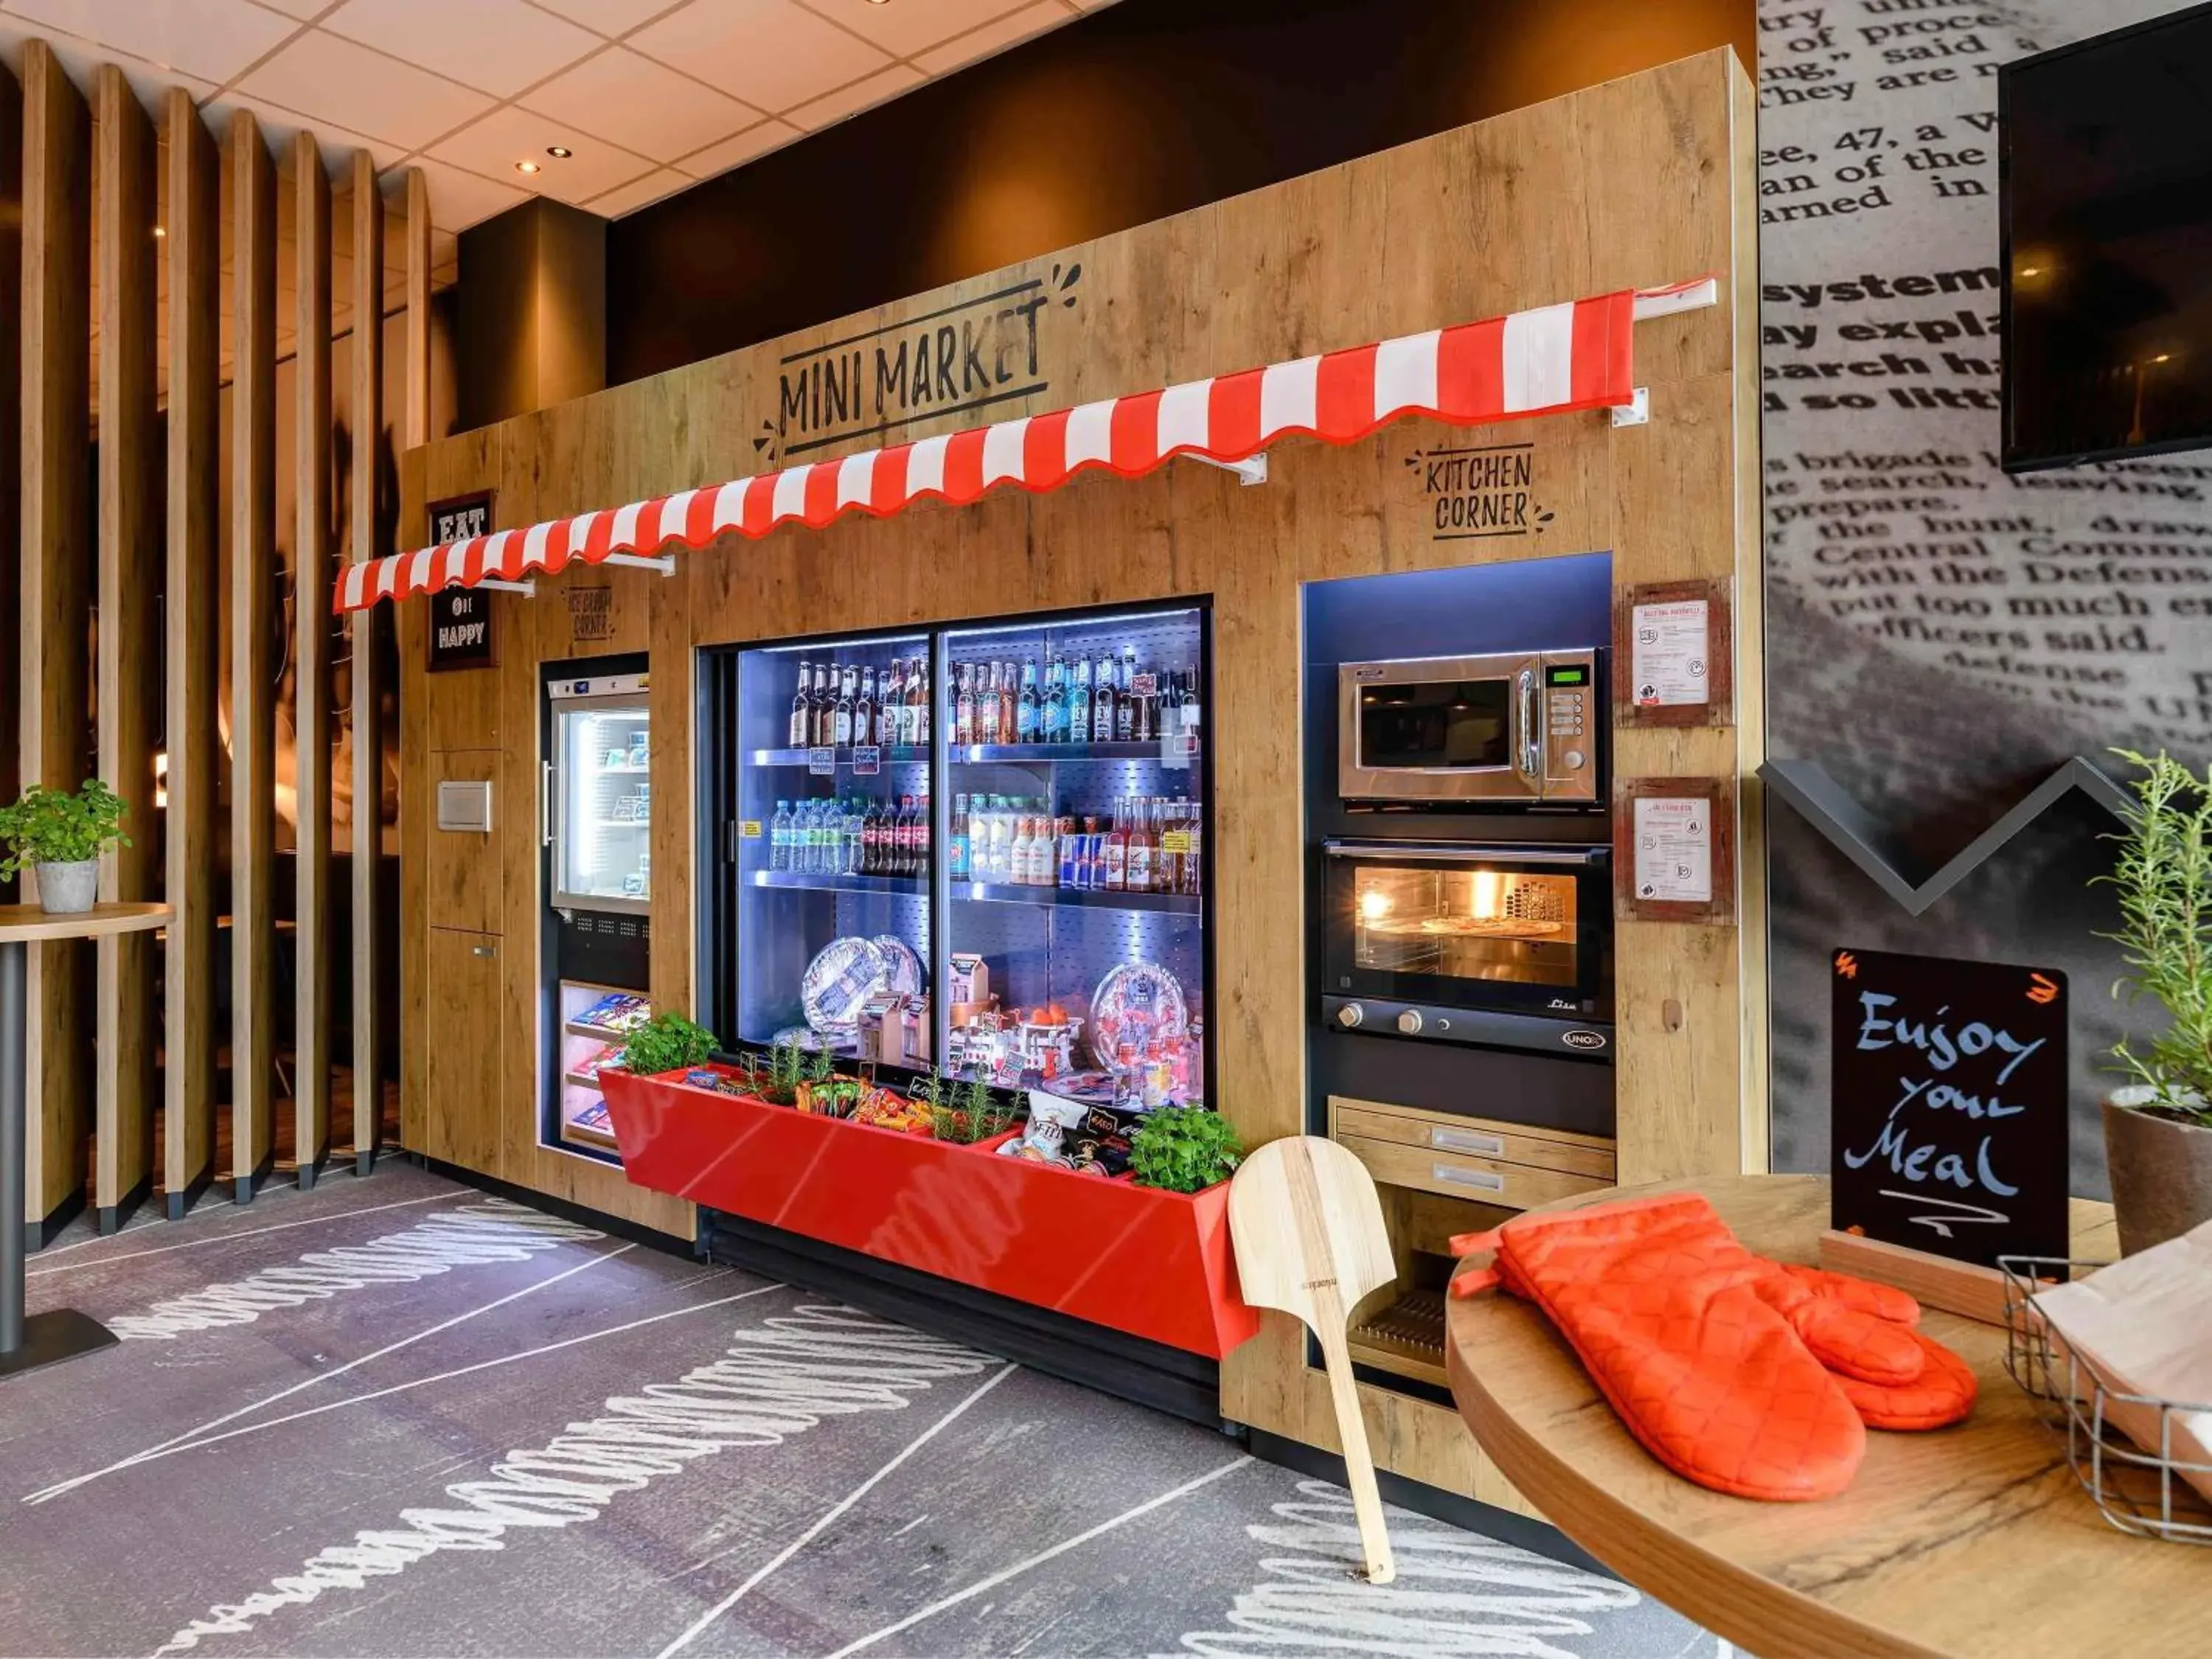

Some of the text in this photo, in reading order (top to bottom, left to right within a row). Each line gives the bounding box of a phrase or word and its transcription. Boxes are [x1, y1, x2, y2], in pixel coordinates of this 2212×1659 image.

[1788, 27, 1836, 53] of
[1882, 34, 1991, 63] said
[1876, 66, 1958, 90] are
[1834, 127, 1899, 151] 47,
[1915, 124, 1947, 142] a
[1834, 155, 1884, 182] of
[1902, 147, 1987, 170] the
[1930, 175, 1989, 198] in
[779, 296, 1048, 438] MINI MARKET
[1801, 394, 1877, 410] so
[1888, 388, 2000, 410] litt
[1427, 453, 1531, 493] KITCHEN
[1795, 450, 1972, 471] brigade
[1436, 492, 1527, 529] CORNER
[439, 507, 484, 544] EAT
[1818, 520, 1891, 540] the
[1814, 537, 1989, 564] Central
[1813, 565, 1918, 588] with
[1932, 562, 2007, 585] the
[1914, 593, 1990, 618] too
[2007, 589, 2152, 616] much
[439, 622, 484, 649] HAPPY
[2044, 623, 2166, 653] said.
[1857, 990, 2046, 1085] Enjoy
[1889, 1077, 2025, 1119] your
[1844, 1119, 2019, 1196] Meal
